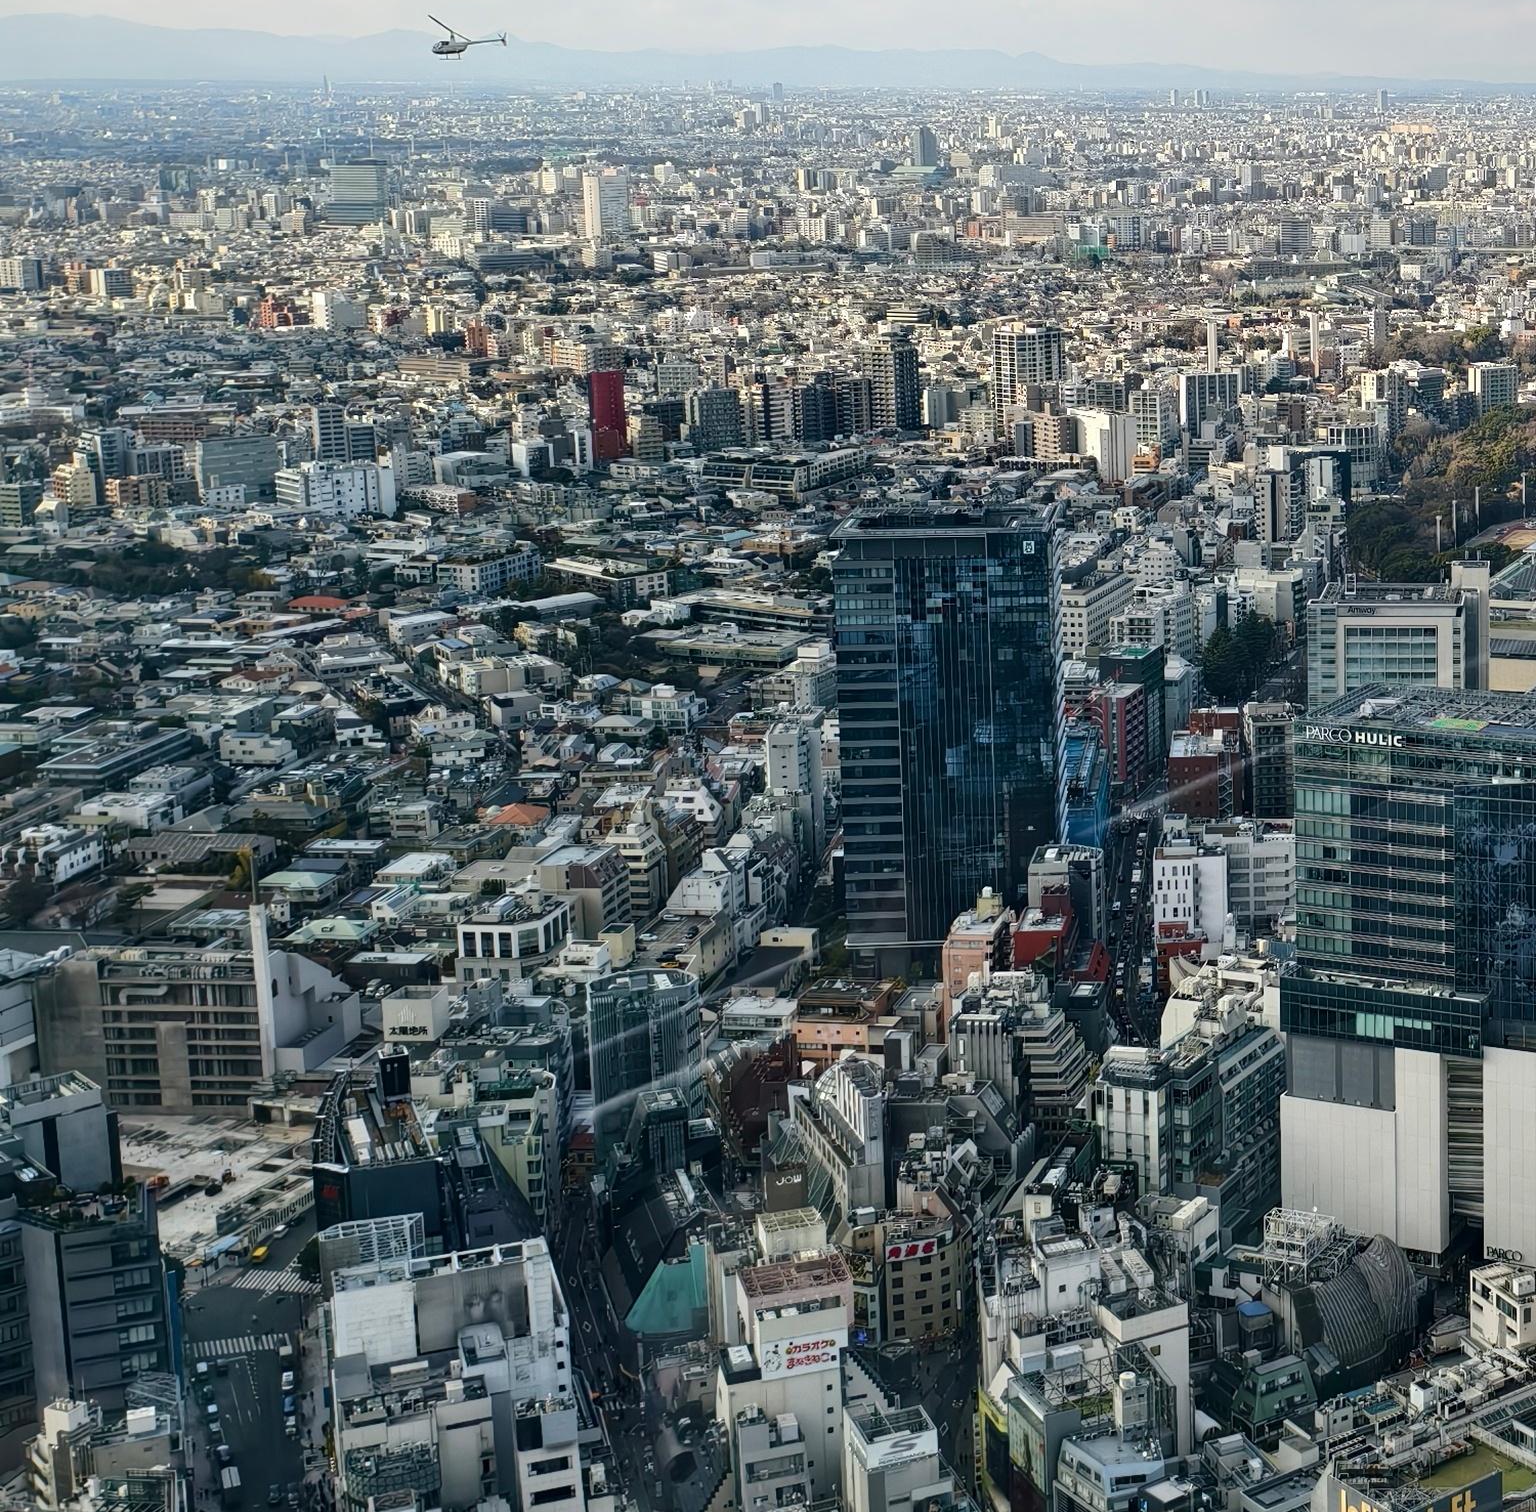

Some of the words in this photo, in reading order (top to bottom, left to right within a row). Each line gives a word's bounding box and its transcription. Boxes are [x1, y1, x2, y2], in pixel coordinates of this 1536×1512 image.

[1347, 606, 1376, 615] Amway
[1306, 726, 1352, 743] PARCO
[1355, 731, 1403, 747] HULIC
[1487, 1246, 1523, 1262] PARCO
[791, 1339, 830, 1354] カラオケ
